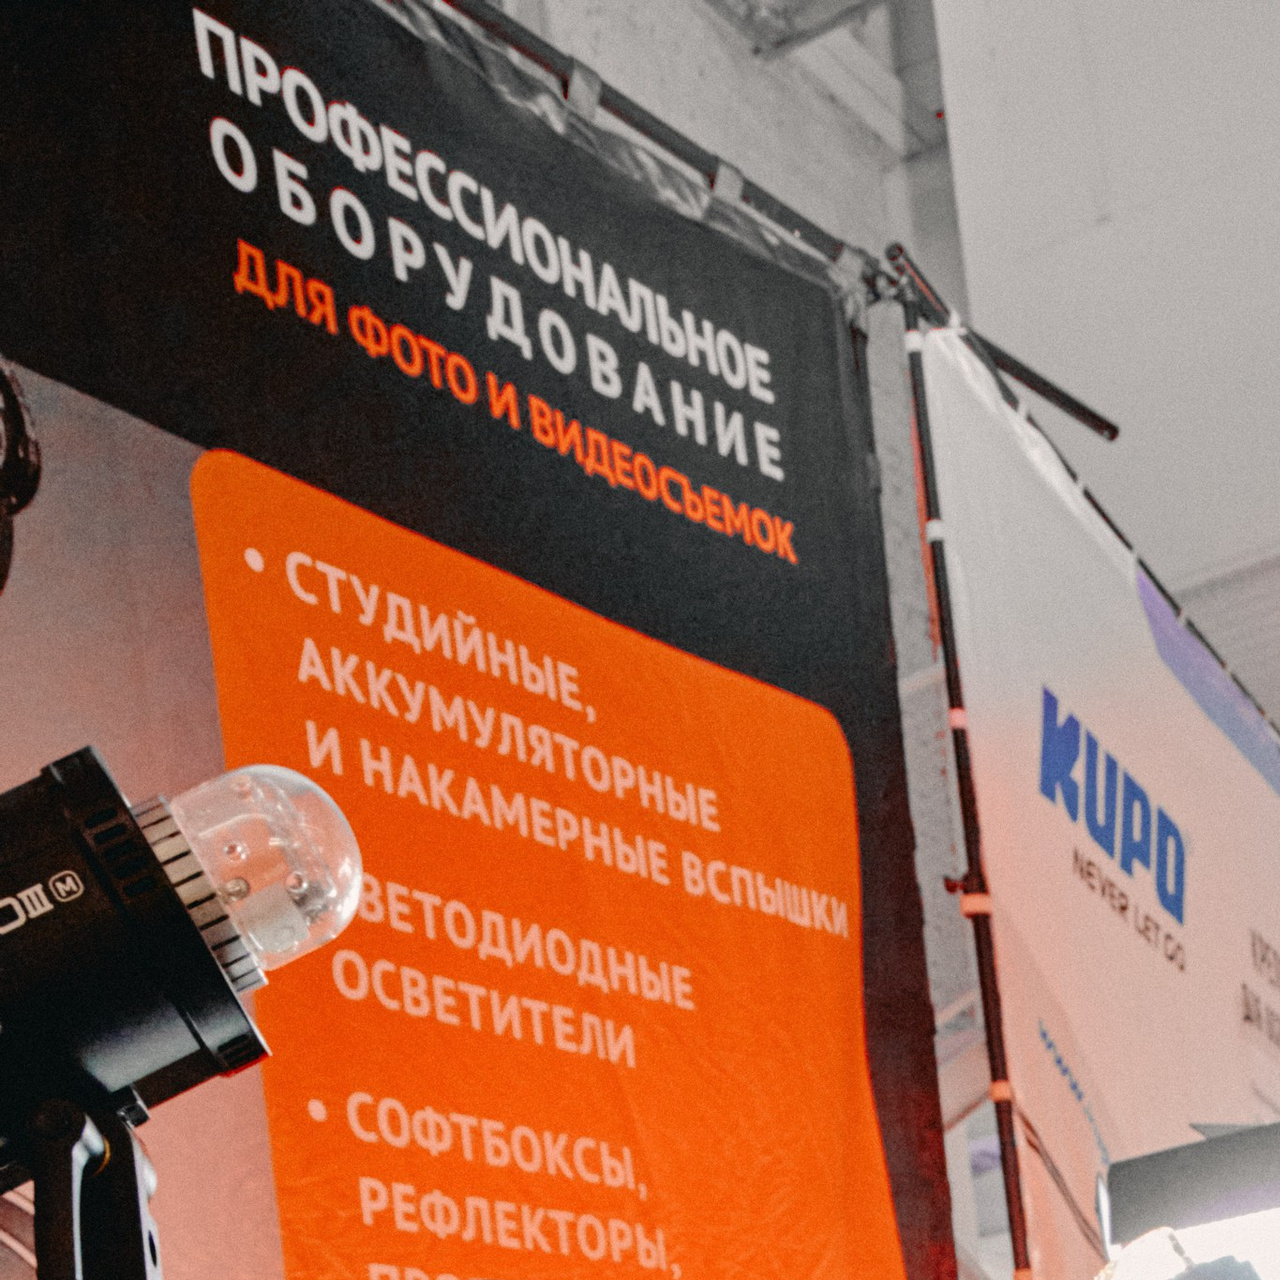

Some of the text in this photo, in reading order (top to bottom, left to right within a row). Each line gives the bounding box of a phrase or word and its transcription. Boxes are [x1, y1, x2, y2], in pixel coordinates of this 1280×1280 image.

[193, 8, 775, 404] ПРОФЕССИОНАЛЬНОЕ
[210, 116, 784, 481] ОБОРУДОВАНИЕ
[234, 238, 798, 563] ДЛЯ ФОТО И ВИДЕОСЪЕМОК
[286, 552, 596, 723] СТУДИЙНЫЕ,
[298, 638, 721, 832] АККУМУЛЯТОРНЫЕ
[305, 720, 849, 939] И НАКАМЕРНЫЕ ВСПЫШКИ
[1039, 686, 1185, 926] KUPO
[331, 949, 636, 1069] ОСВЕТИТЕЛИ
[357, 872, 696, 1011] ВЕТОДИОДНЫЕ
[345, 1091, 647, 1201] СОФТБОКСЫ,
[359, 1176, 682, 1280] РЕФЛЕКТОРЫ,
